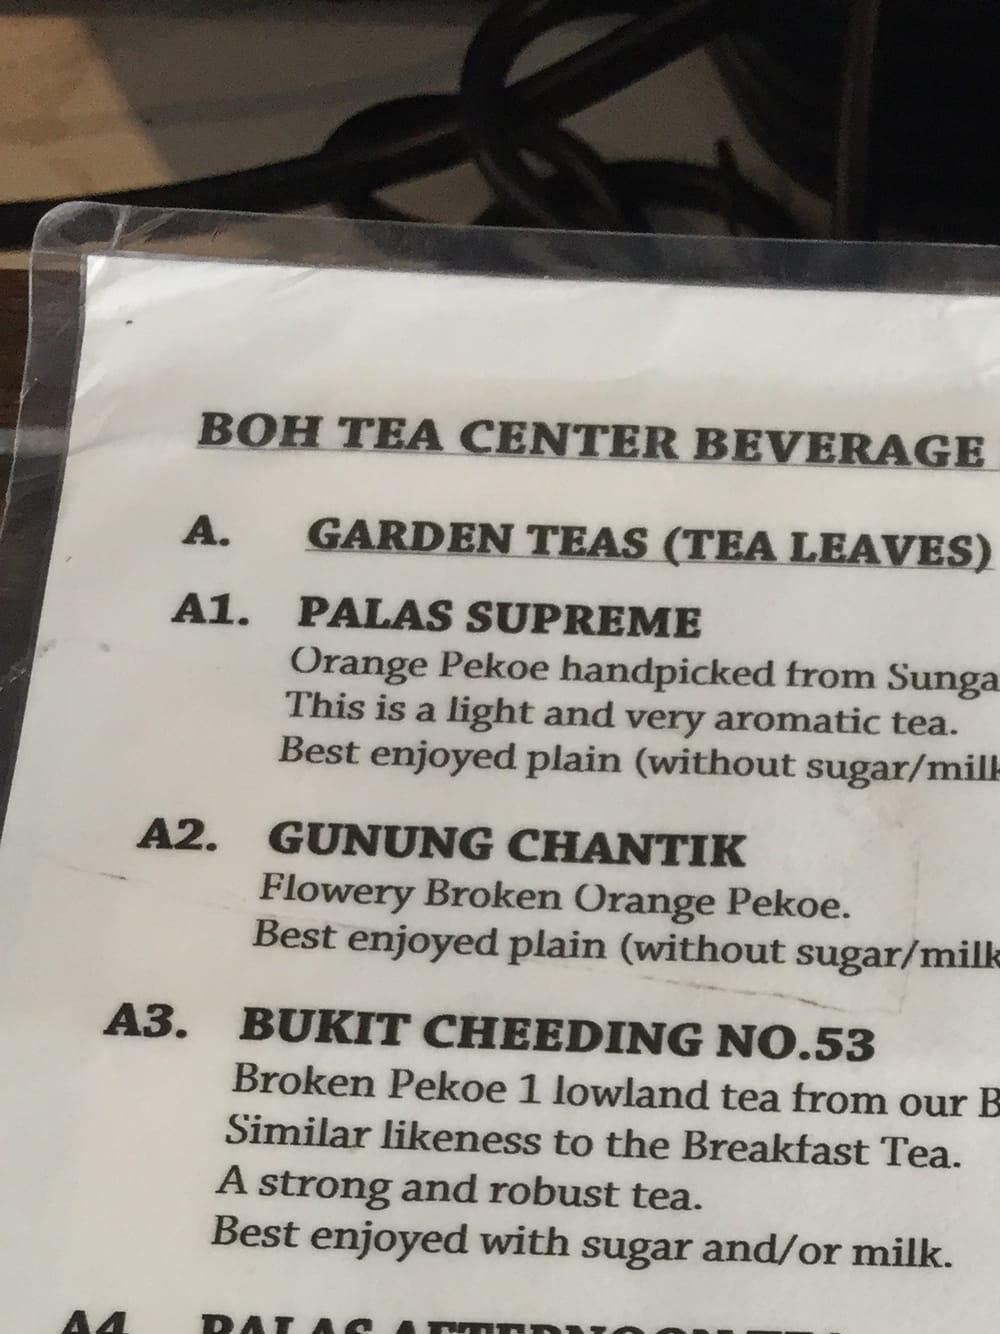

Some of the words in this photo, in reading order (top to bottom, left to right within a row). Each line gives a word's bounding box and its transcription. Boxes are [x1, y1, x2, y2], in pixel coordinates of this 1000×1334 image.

[197, 411, 324, 451] BOH
[337, 415, 445, 454] TEA
[459, 418, 680, 462] CENTER
[692, 426, 986, 472] BEVERAGE
[181, 514, 230, 547] A.
[306, 516, 515, 555] GARDEN
[526, 524, 648, 563] TEAS
[660, 525, 778, 568] (TEA
[789, 531, 992, 575] LEAVES)
[170, 592, 250, 626] A1.
[297, 595, 453, 633] PALAS
[465, 600, 702, 639] SUPREME
[290, 646, 428, 686] Orange
[438, 650, 550, 681] Pekoe
[559, 654, 776, 694] handpicked
[786, 660, 876, 689] from
[285, 690, 366, 721] This
[375, 693, 406, 722] is
[415, 702, 437, 723] a
[446, 695, 535, 733] light
[543, 700, 616, 728] and
[624, 709, 707, 740] very
[714, 707, 881, 736] aromatic
[891, 711, 958, 736] tea.
[278, 735, 361, 765] Best
[370, 739, 517, 777] enjoyed
[525, 744, 622, 780] plain
[635, 747, 797, 780] (without
[135, 817, 218, 852] A2.
[268, 820, 494, 861] GUNUNG
[507, 828, 747, 868] CHANTIK
[102, 1001, 188, 1040] A3.
[238, 1006, 412, 1047] BUKIT
[422, 1013, 704, 1058] CHEEDING
[715, 1023, 875, 1063] NO.53
[231, 1062, 376, 1098] Broken
[387, 1068, 507, 1104] Pekoe
[519, 1073, 542, 1104] 1
[552, 1074, 710, 1111] lowland
[720, 1083, 781, 1113] tea
[791, 1081, 889, 1115] from
[899, 1093, 969, 1118] our
[224, 1113, 373, 1149] Similar
[380, 1119, 542, 1156] likeness
[553, 1129, 594, 1158] to
[605, 1128, 670, 1160] the
[681, 1129, 870, 1166] Breakfast
[879, 1135, 961, 1169] Tea.
[210, 1214, 301, 1248] Best
[309, 1220, 469, 1263] enjoyed
[479, 1225, 571, 1257] with
[581, 1236, 694, 1271] sugar
[702, 1232, 843, 1266] and/or
[851, 1236, 953, 1269] milk.
